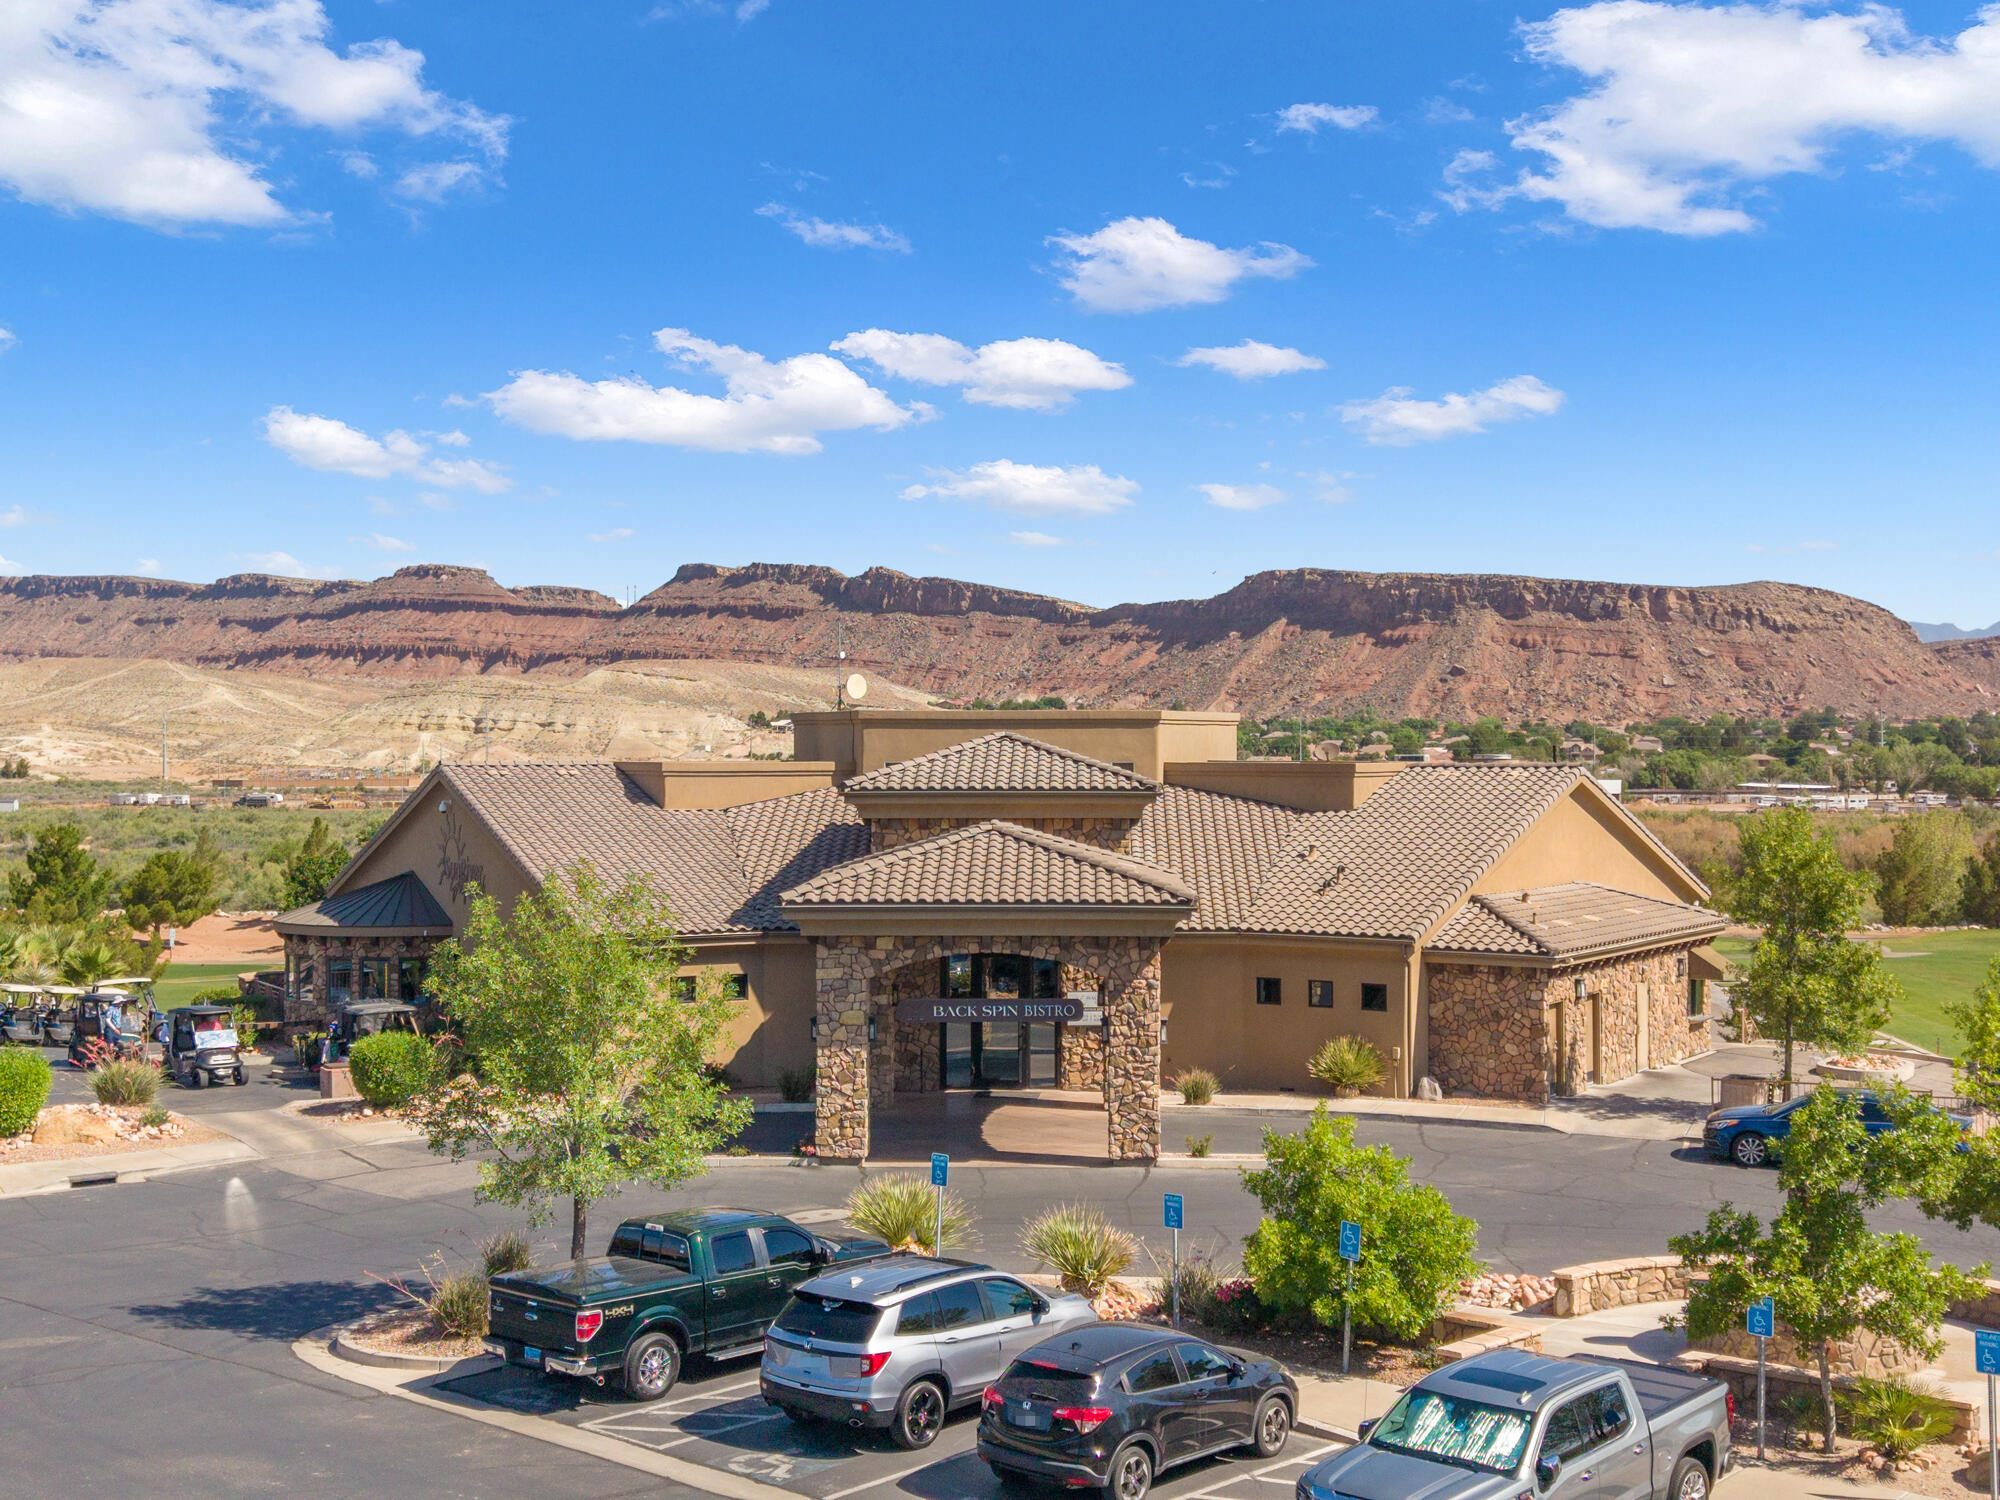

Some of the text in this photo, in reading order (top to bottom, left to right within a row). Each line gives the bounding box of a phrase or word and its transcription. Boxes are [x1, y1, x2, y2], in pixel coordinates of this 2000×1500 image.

[933, 1005, 977, 1017] BACK
[982, 1005, 1018, 1017] SPIN
[1024, 1004, 1075, 1017] BISTRO
